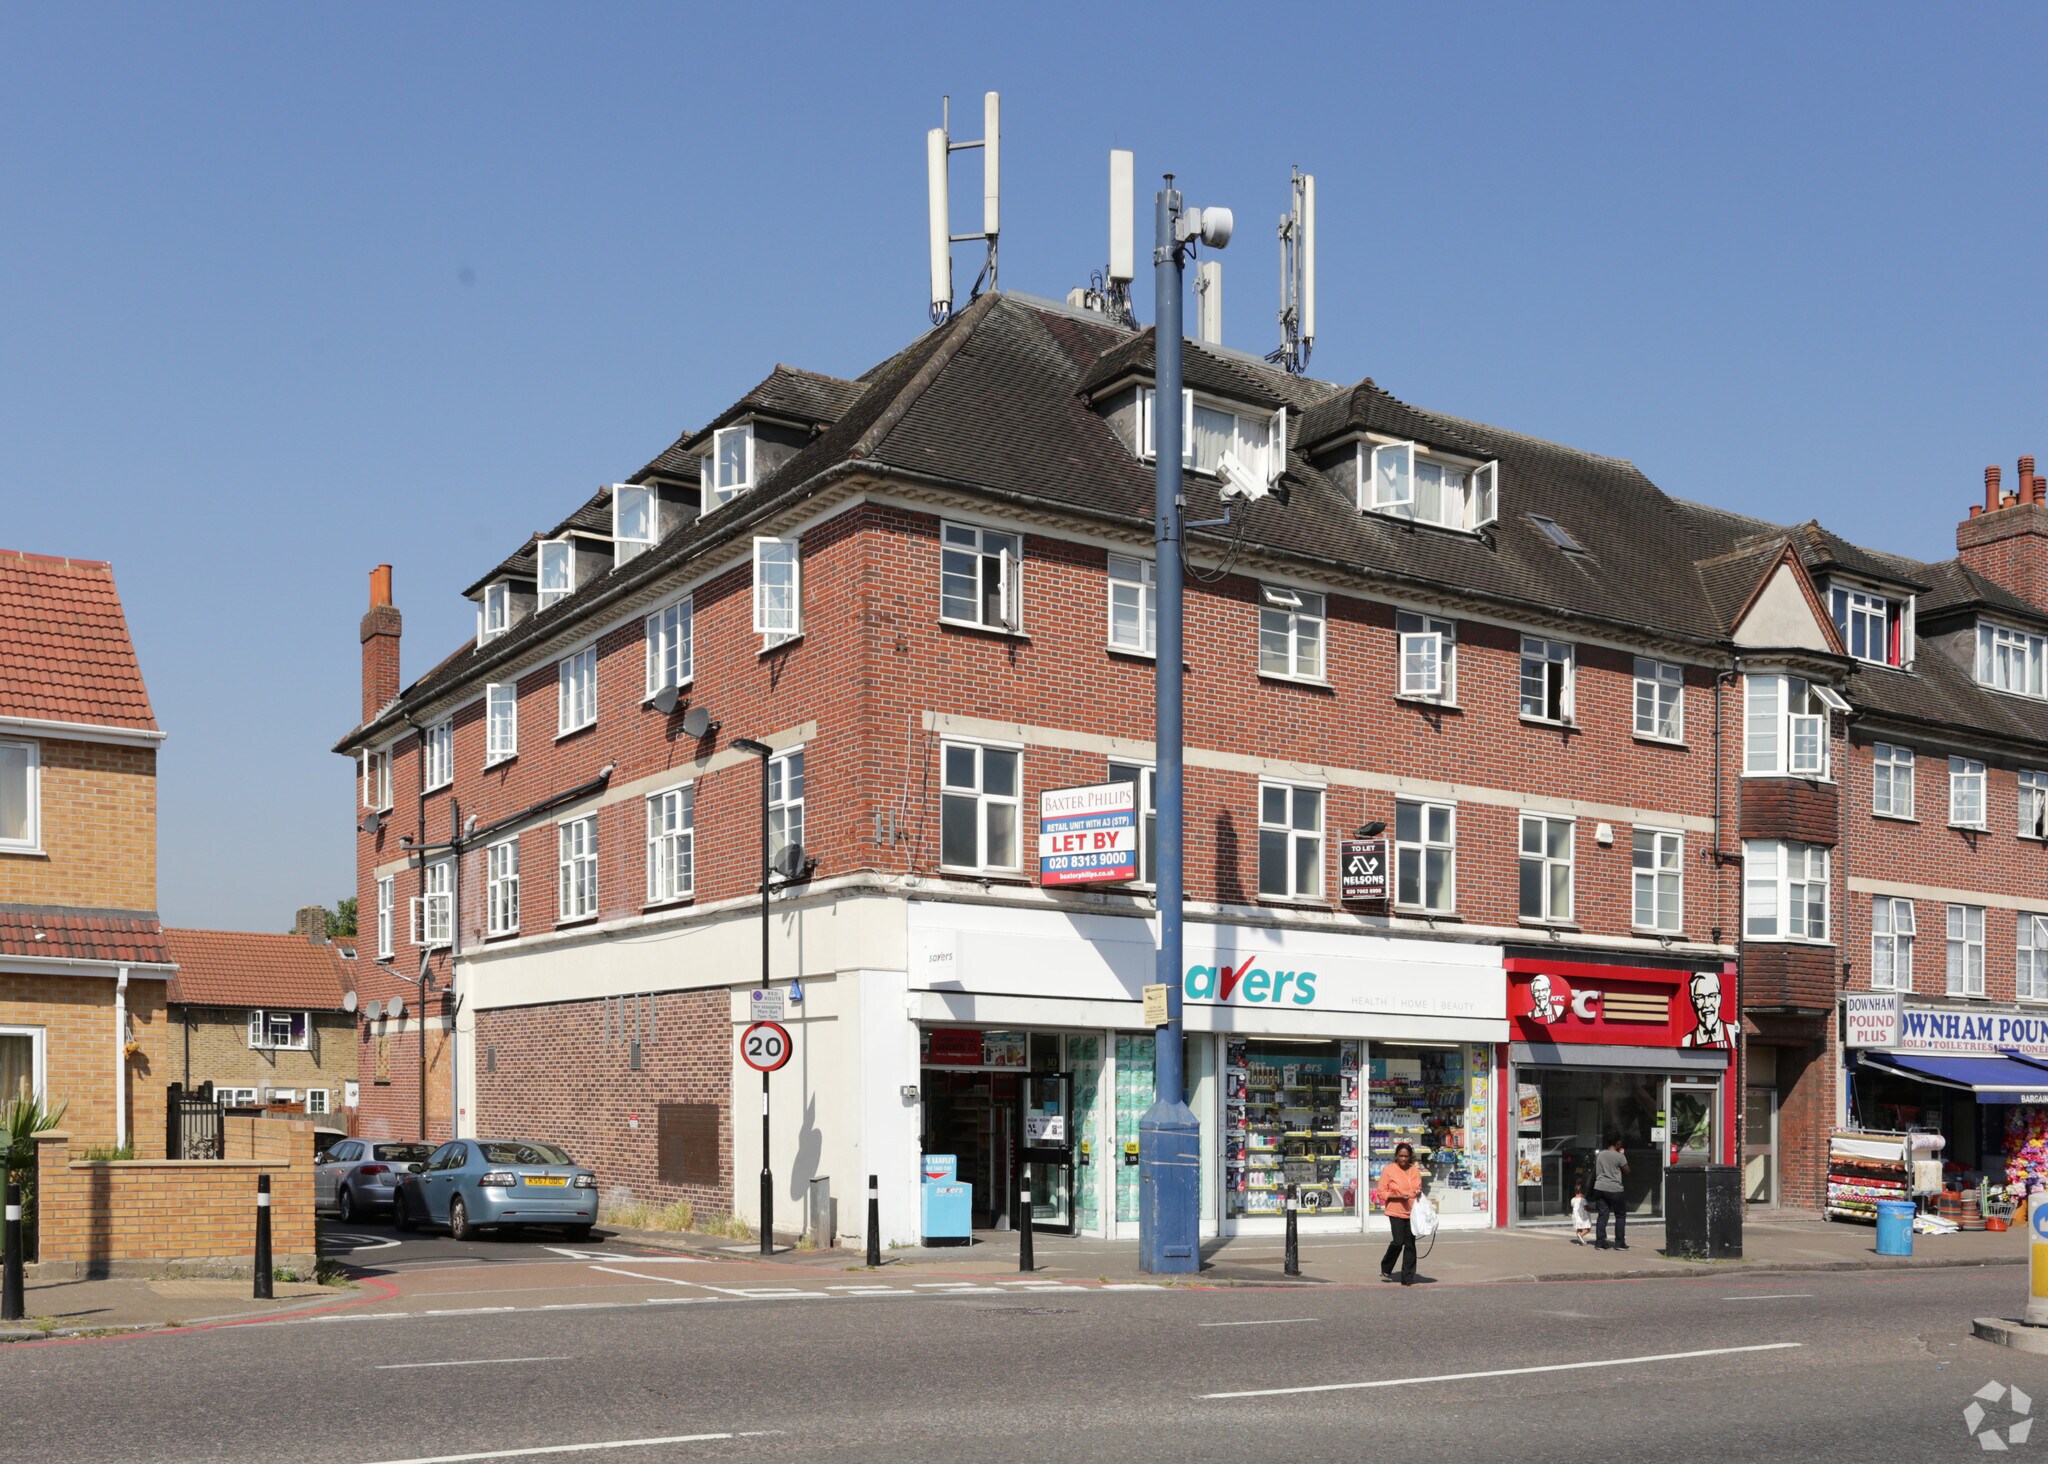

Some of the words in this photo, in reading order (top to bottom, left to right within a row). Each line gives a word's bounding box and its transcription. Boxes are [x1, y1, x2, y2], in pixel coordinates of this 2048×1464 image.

[1045, 796, 1084, 812] BAXTER
[1088, 790, 1132, 807] PHILIPS
[1047, 823, 1068, 833] RETAIL
[1070, 821, 1085, 831] UNIT
[1086, 820, 1102, 829] WITH
[1102, 819, 1111, 827] A3
[1111, 816, 1130, 827] (STP)
[1052, 834, 1087, 853] LET
[1094, 831, 1120, 850] BY
[1049, 858, 1068, 870] 020
[1071, 855, 1098, 868] 8313
[1100, 852, 1126, 866] 9000
[1060, 869, 1115, 880] baxterphilips.co.uk
[1343, 875, 1384, 886] NELSONS
[929, 952, 953, 963] savers
[1351, 996, 1387, 1006] HEALTH
[1401, 1000, 1428, 1008] HOME
[1441, 1001, 1474, 1011] BEAUTY
[1849, 998, 1895, 1011] DOWNHAM
[1849, 1015, 1895, 1027] POUND
[1857, 1030, 1887, 1042] PLUS
[748, 1036, 782, 1057] 20
[1933, 1041, 1994, 1051] TOILETRIES
